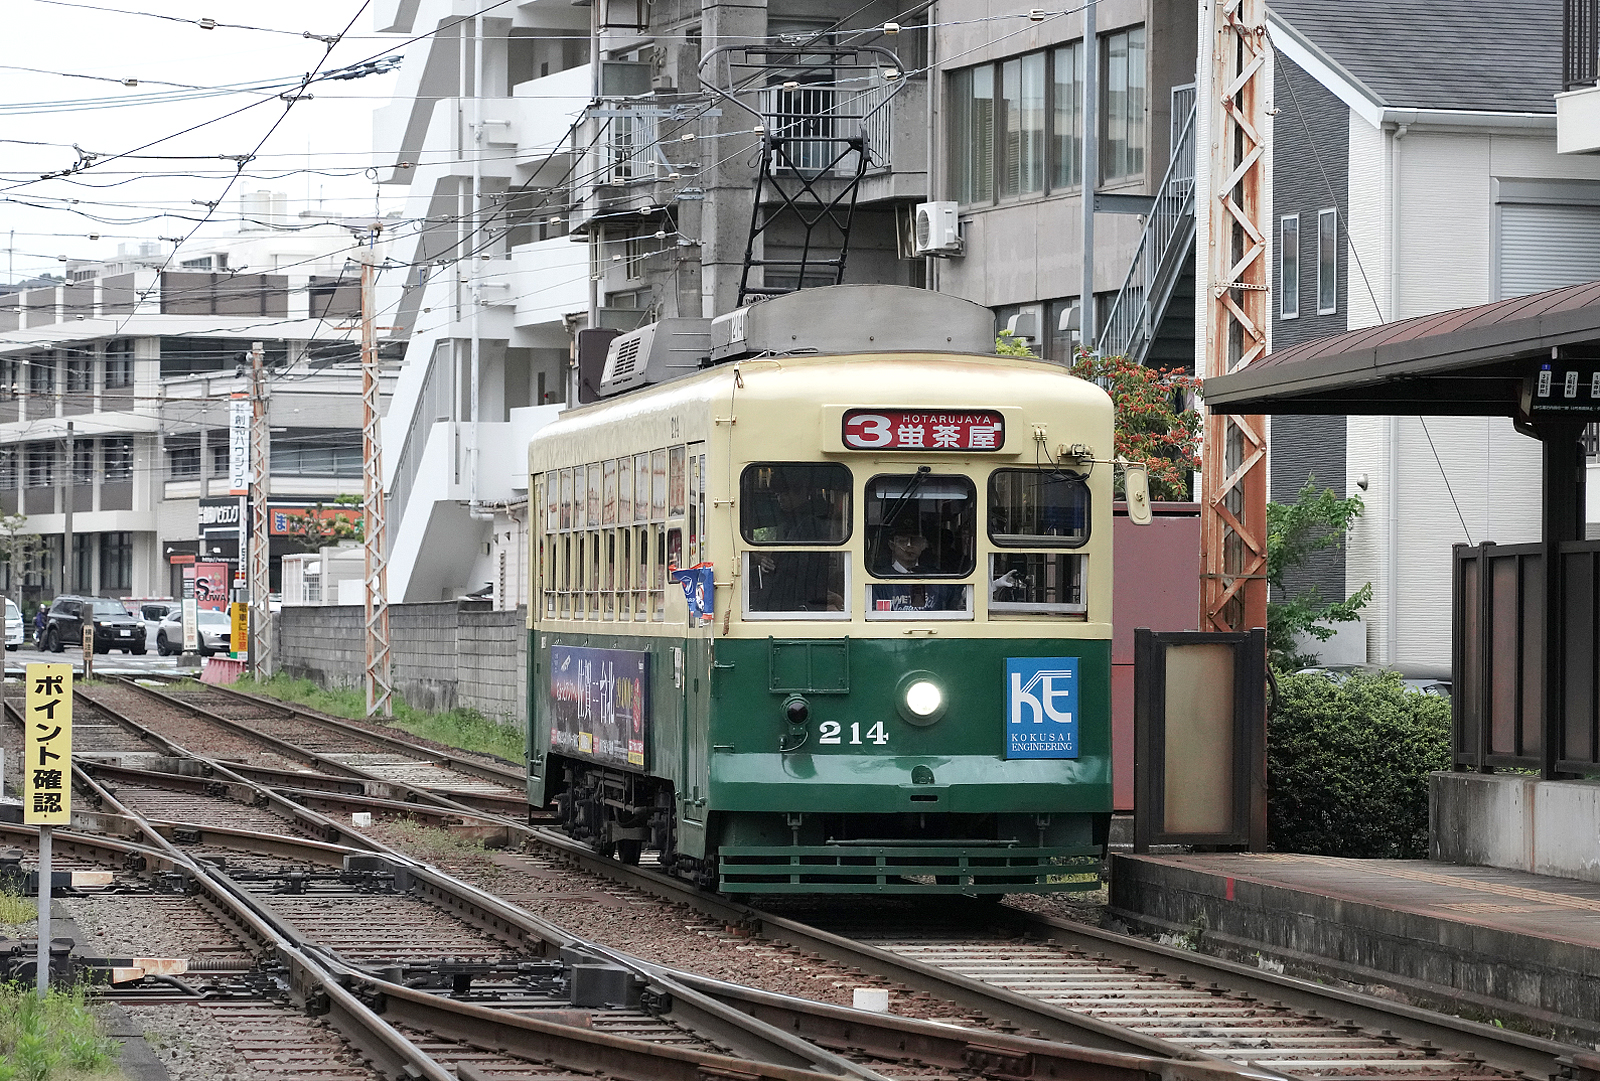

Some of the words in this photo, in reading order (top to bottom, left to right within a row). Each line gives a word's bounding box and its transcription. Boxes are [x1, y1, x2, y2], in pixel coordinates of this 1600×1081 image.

[902, 414, 991, 424] HOTARUJAYA
[846, 414, 893, 448] 3
[897, 424, 996, 448] 蛍茶屋
[1011, 670, 1072, 723] KE
[33, 675, 64, 813] ポイント確認
[819, 721, 889, 744] 214
[1011, 733, 1071, 741] KOKUSAI
[1011, 742, 1072, 751] ENGINEERING
